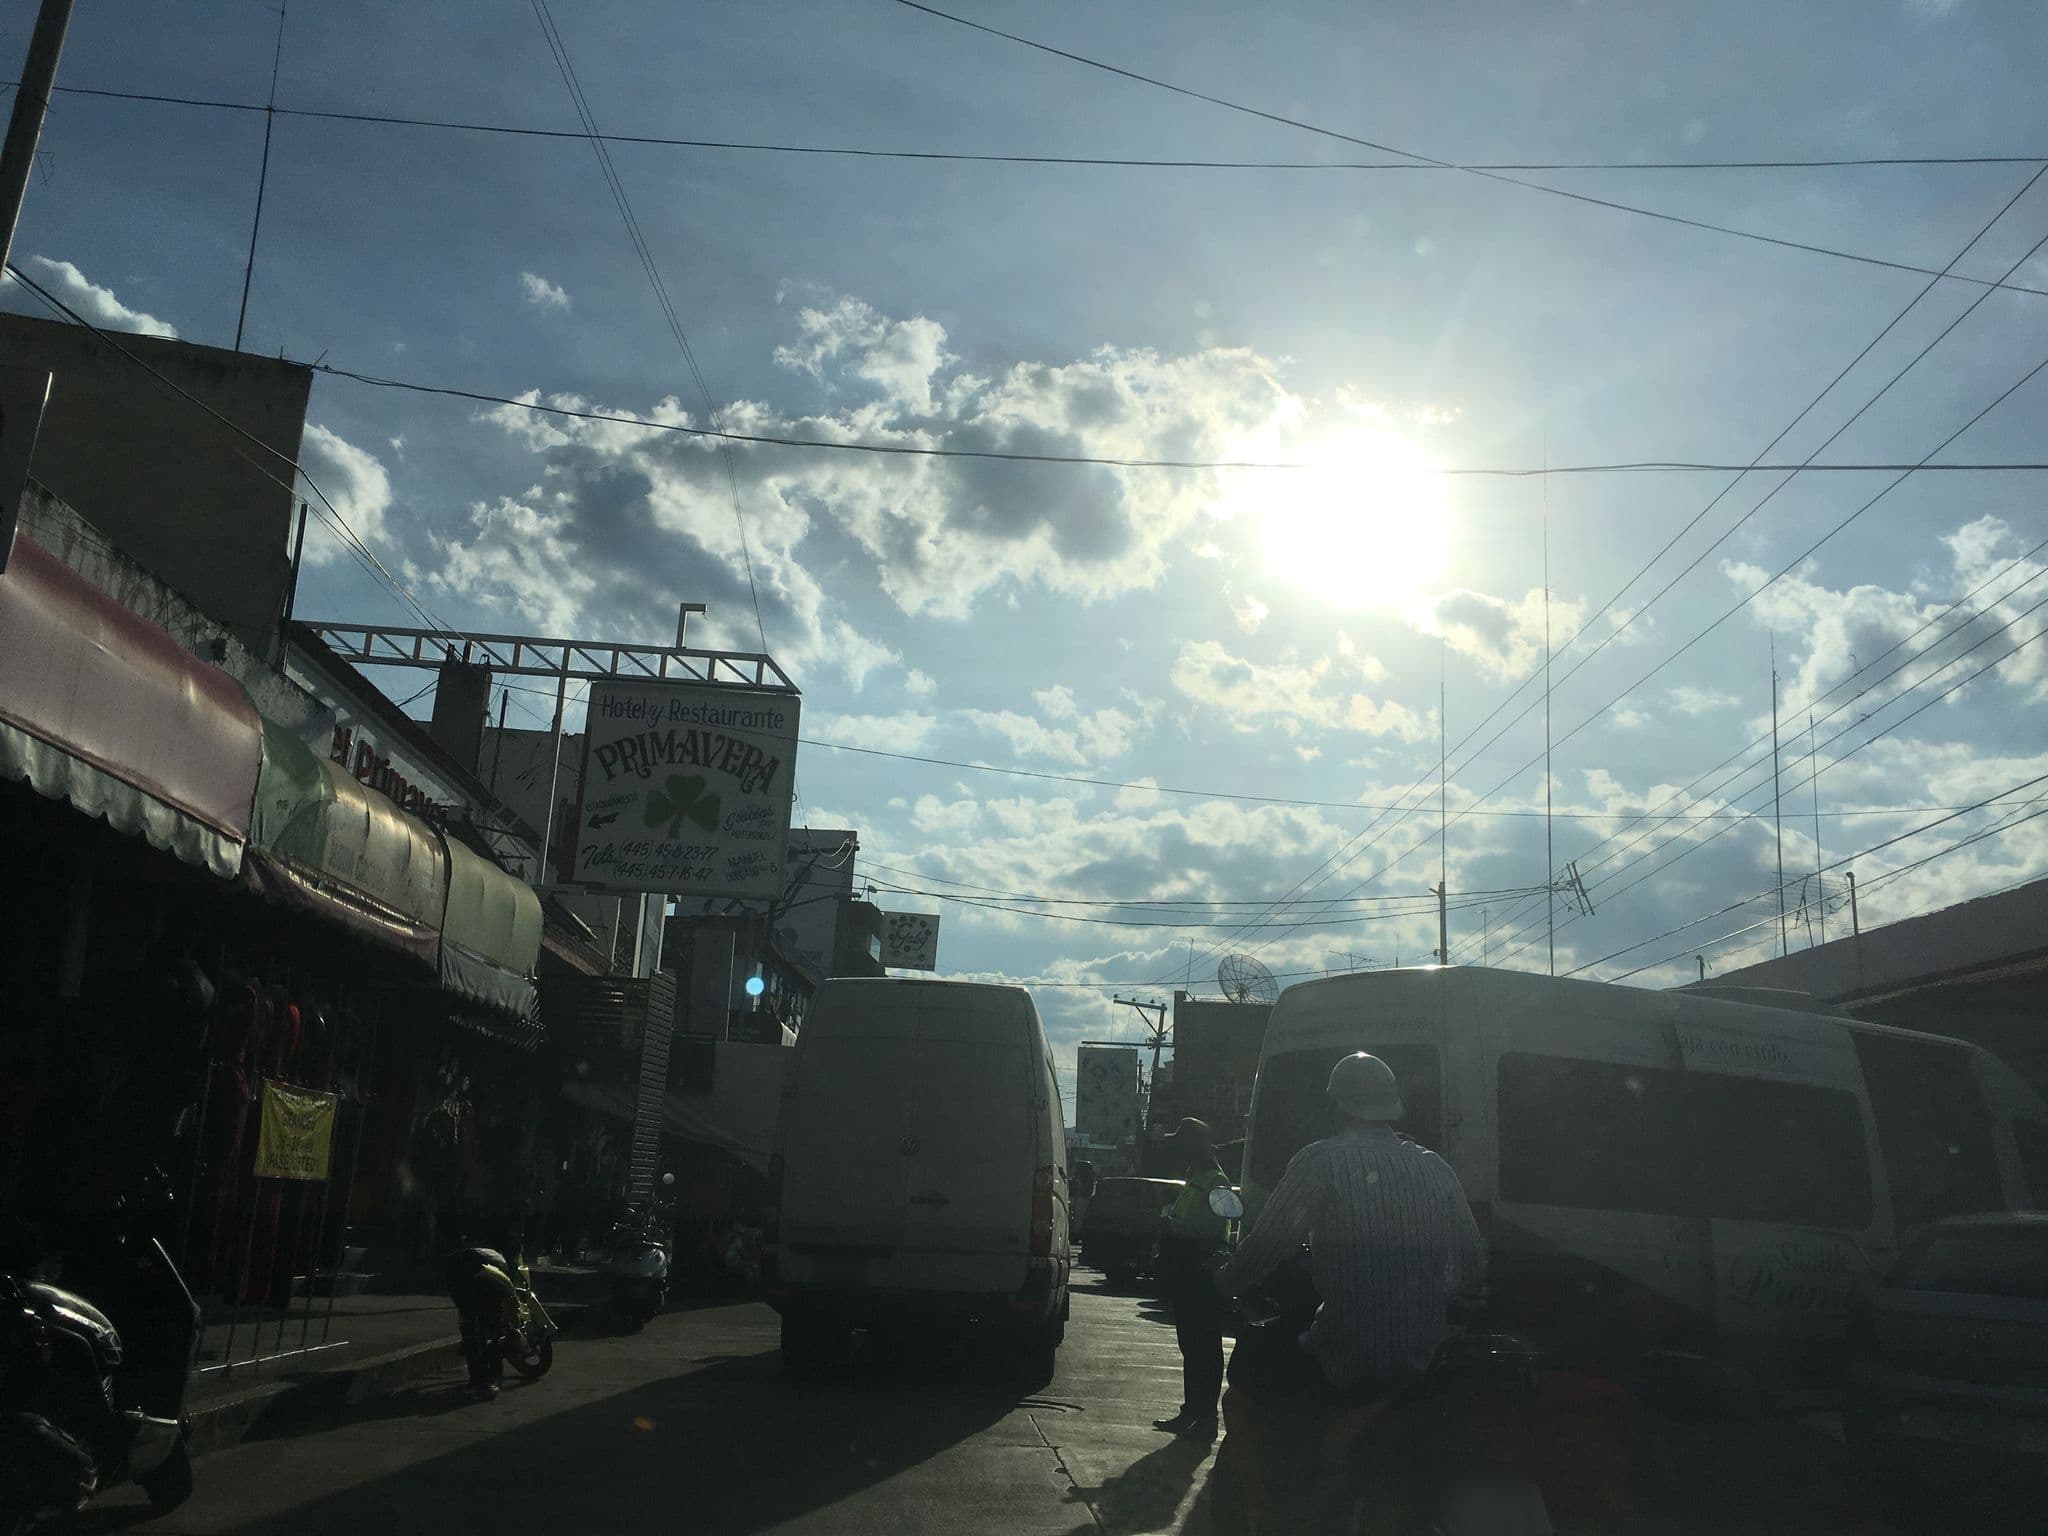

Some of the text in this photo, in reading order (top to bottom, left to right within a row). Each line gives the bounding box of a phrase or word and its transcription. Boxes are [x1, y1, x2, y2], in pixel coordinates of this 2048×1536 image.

[602, 694, 785, 729] Hotel y Restaurante
[593, 729, 780, 795] PRIMAVERA
[619, 839, 654, 859] (445)
[613, 861, 648, 881] (445)
